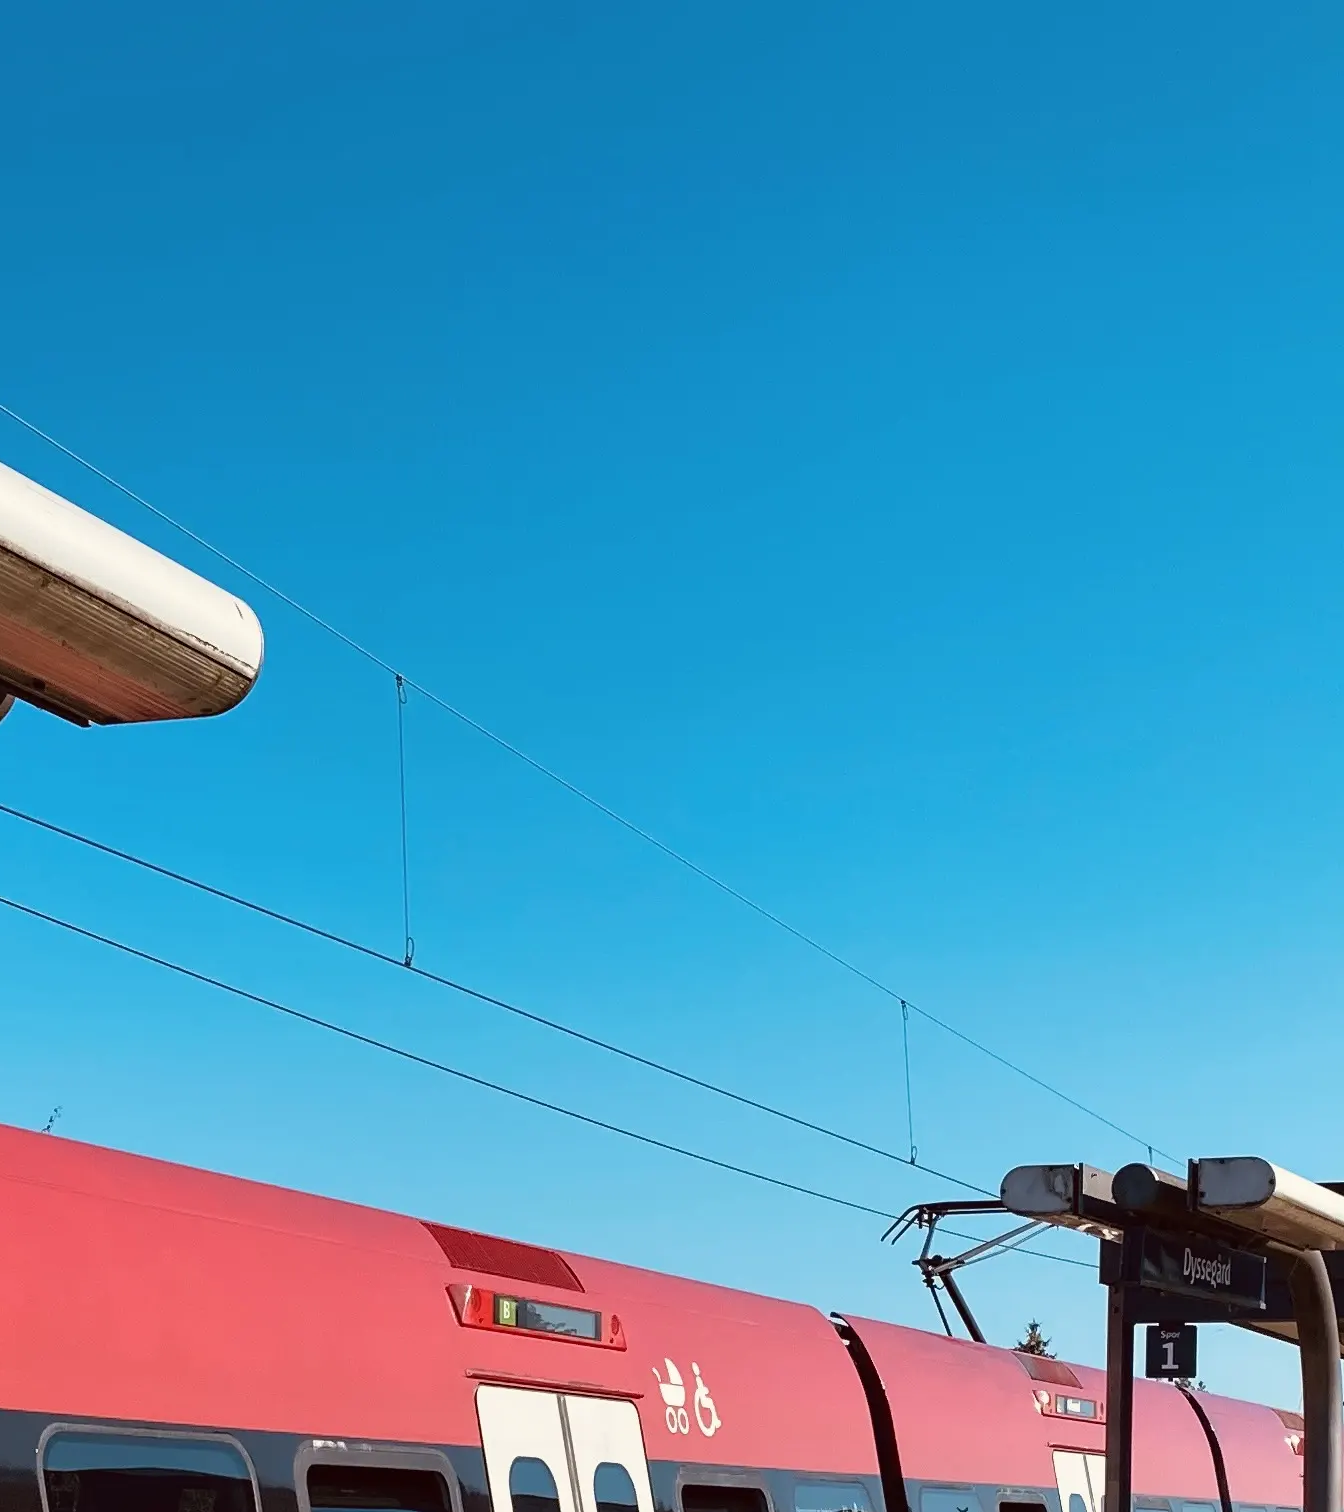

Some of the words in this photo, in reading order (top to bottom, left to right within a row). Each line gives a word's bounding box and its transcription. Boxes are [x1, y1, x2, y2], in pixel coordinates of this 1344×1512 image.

[1183, 1247, 1231, 1288] Dyssegård
[503, 1300, 511, 1319] B
[1161, 1330, 1180, 1340] Spor
[1161, 1342, 1179, 1370] 1
